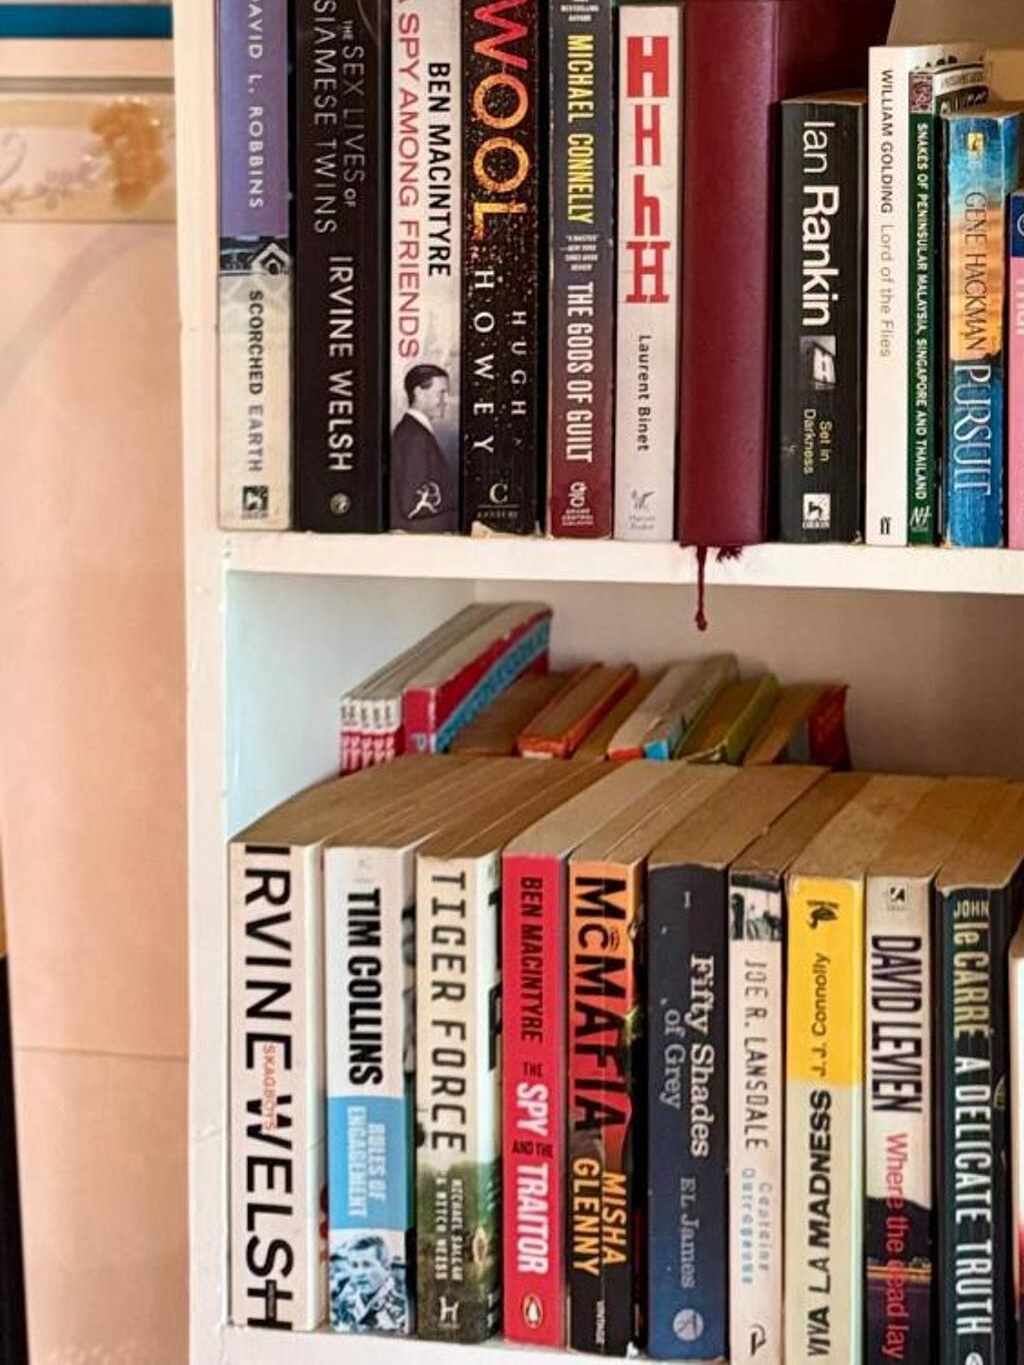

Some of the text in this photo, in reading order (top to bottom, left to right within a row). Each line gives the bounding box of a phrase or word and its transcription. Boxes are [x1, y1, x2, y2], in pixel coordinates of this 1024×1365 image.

[342, 45, 364, 183] SEX LIVES
[567, 34, 594, 124] MICHAEL
[879, 69, 893, 214] WILLIAM GOLDING
[248, 106, 264, 208] ROBBINS
[313, 139, 338, 234] TWINS
[397, 12, 421, 358] SPY AMONG FRIENDS
[428, 62, 452, 277] BEN MACINTYRE
[567, 132, 595, 225] CONNELLY
[625, 36, 671, 304] HHhH
[801, 120, 840, 327] Ian Rankin
[567, 281, 594, 317] THE
[963, 191, 988, 351] GENE HACKMAN
[248, 289, 264, 472] SCORCHED EARTH
[328, 256, 354, 471] IRVINE WELSH
[472, 269, 496, 454] HOWEY
[566, 322, 594, 374] GODS
[566, 380, 594, 404] OF
[637, 335, 653, 452] Laurent Binet
[566, 410, 594, 463] GUILT
[802, 408, 817, 475] Darkness
[953, 363, 992, 496] PURSUIT
[244, 844, 293, 1071] IRVINE
[347, 887, 384, 1087] TIM COLLINS
[430, 870, 467, 1154] TIGER FORCE
[516, 876, 549, 1137] BEN MACINTYRE SPY
[811, 952, 832, 1037] Connolly
[870, 934, 923, 1114] DAVID LEVIEN
[659, 1011, 687, 1110] of Grey
[685, 954, 715, 1158] Fifty Shades
[743, 958, 768, 1150] JOE LANSDALE
[246, 1094, 294, 1331] WELSH
[347, 1105, 368, 1218] ENGAGEMENT
[517, 1162, 549, 1276] TRAITOR
[573, 1157, 600, 1277] GLENNY
[602, 1171, 628, 1265] MISHA
[806, 1088, 832, 1357] VIVA LA MADNESS
[884, 1132, 909, 1209] Where
[954, 1083, 993, 1336] DELICATE TRUTH
[680, 1213, 699, 1289] James
